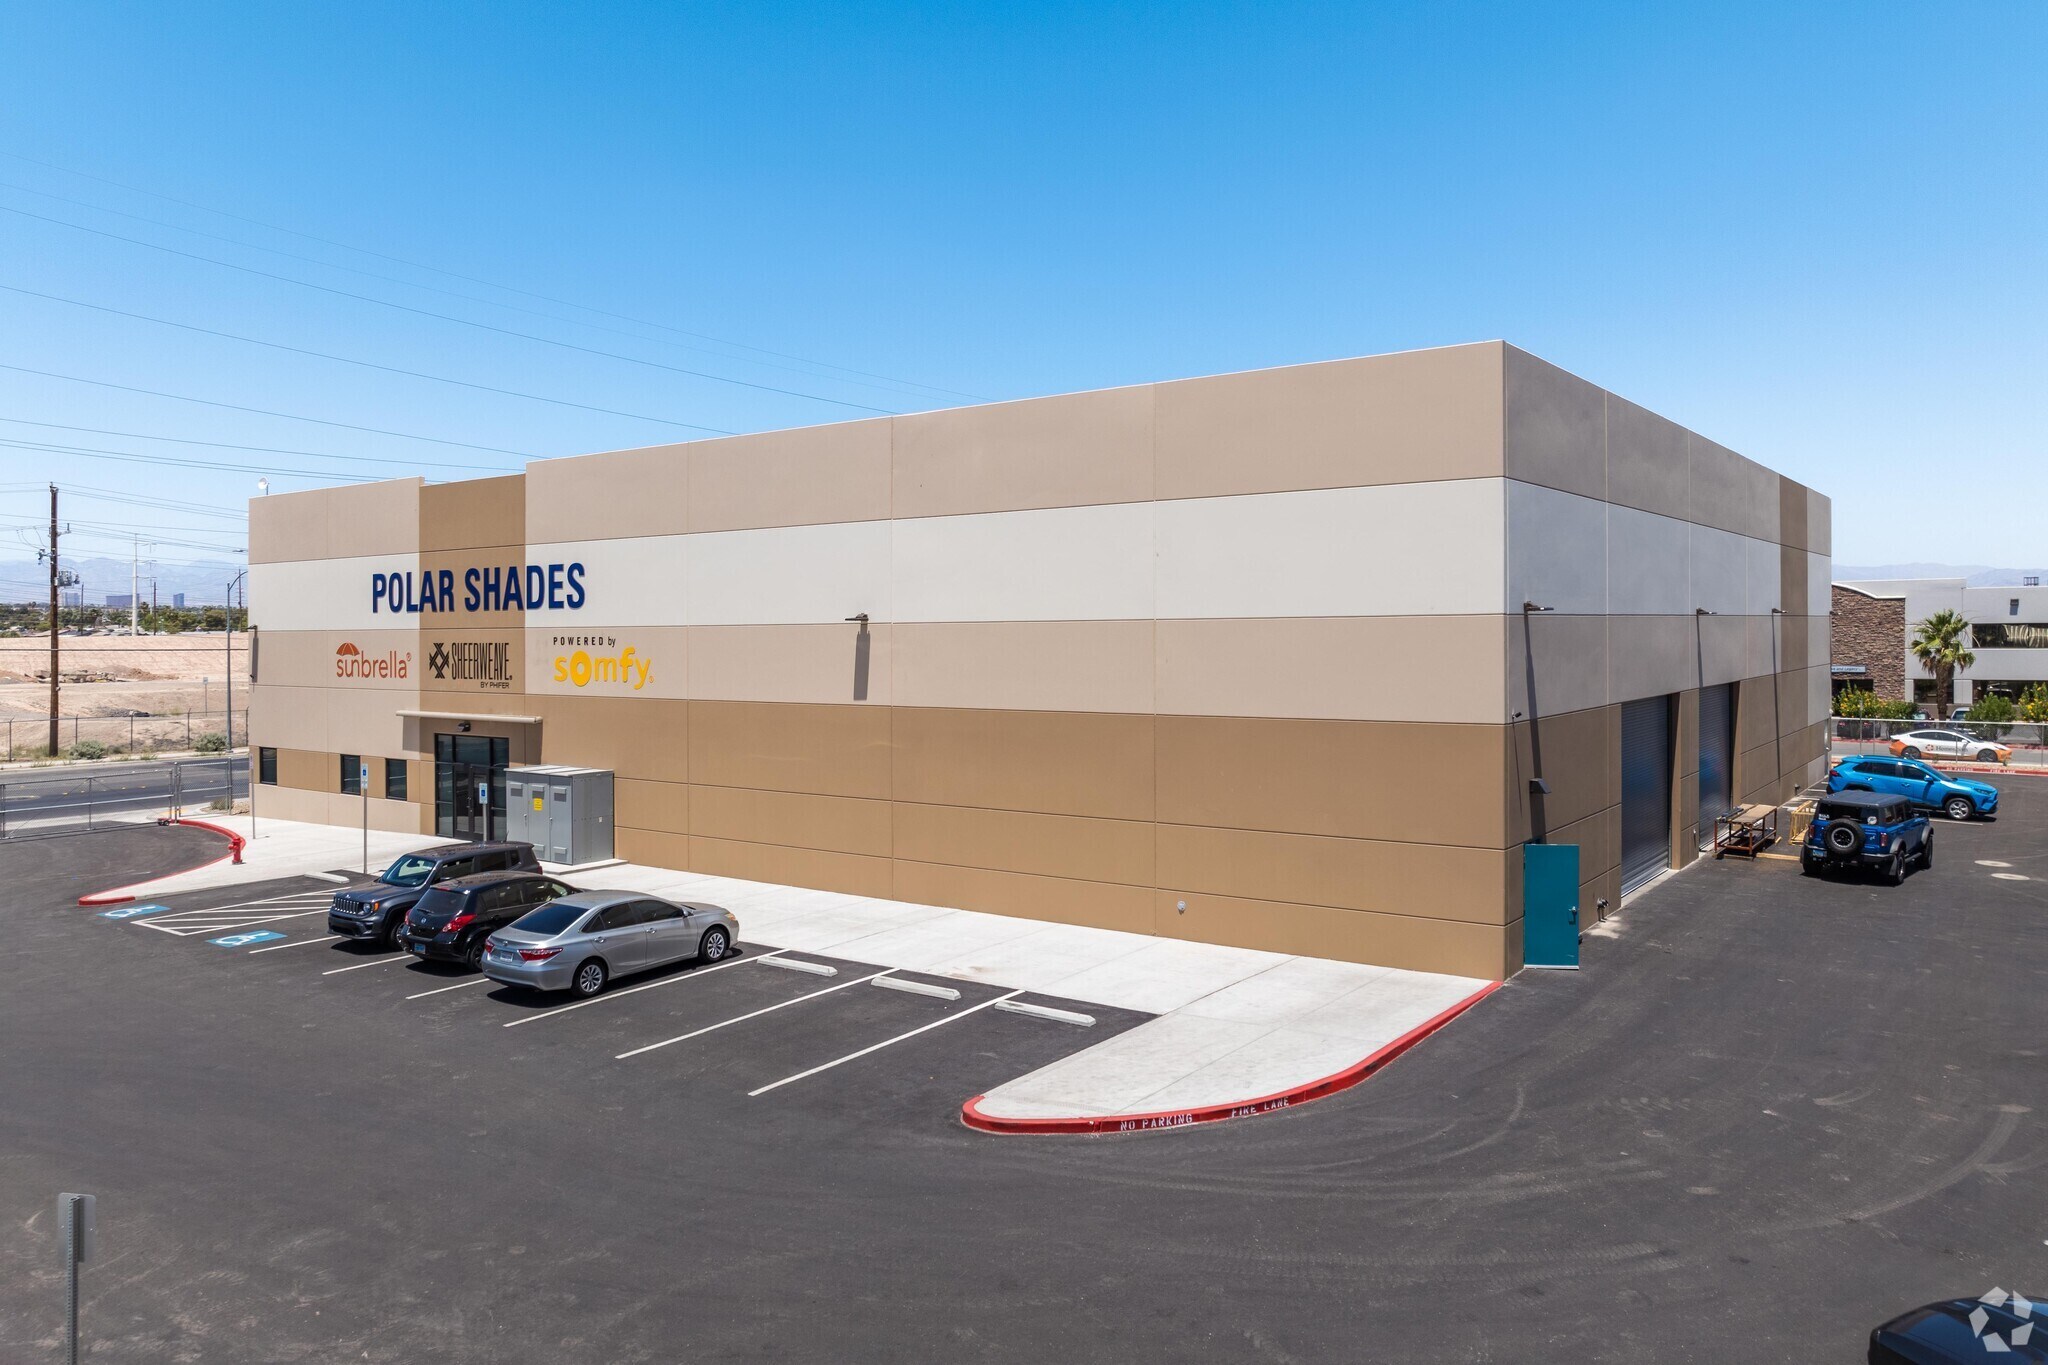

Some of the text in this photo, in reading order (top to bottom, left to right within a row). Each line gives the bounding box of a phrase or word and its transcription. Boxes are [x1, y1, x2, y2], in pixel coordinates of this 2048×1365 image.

[372, 562, 586, 614] POLAR SHADES
[553, 636, 616, 648] POWERED by
[489, 682, 510, 690] PHIFER
[1231, 1096, 1290, 1118] FIRE LANE
[1120, 1113, 1193, 1131] NO PARKING
